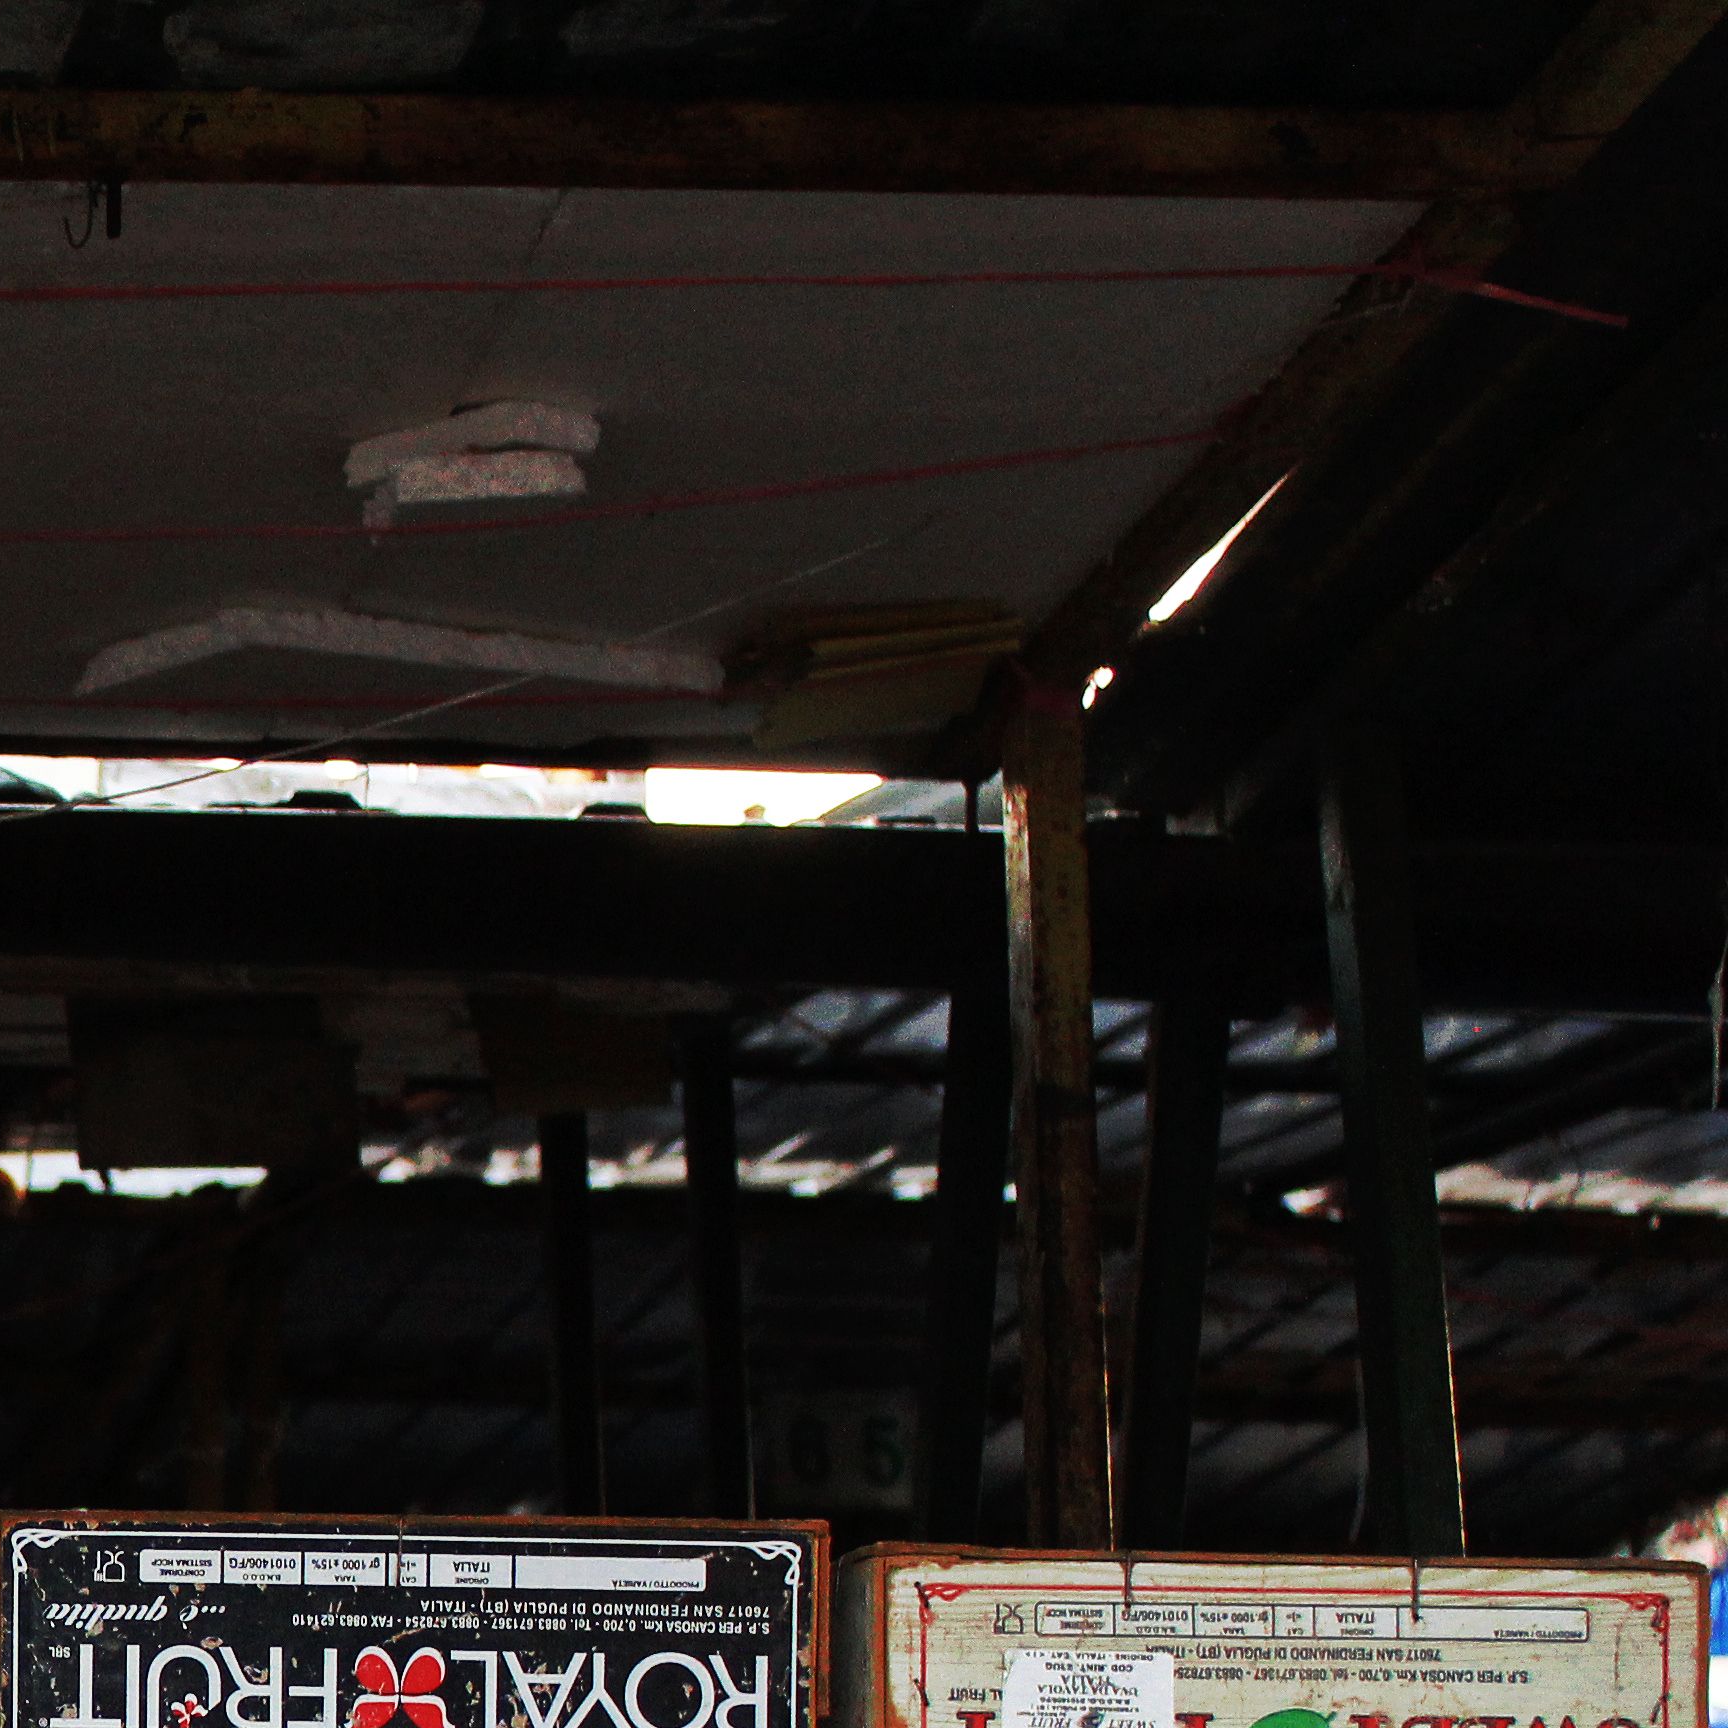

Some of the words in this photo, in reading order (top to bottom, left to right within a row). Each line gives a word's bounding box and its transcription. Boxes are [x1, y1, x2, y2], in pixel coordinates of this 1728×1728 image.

[229, 1557, 296, 1568] 0101406/FG
[453, 1560, 490, 1572] ITALIA
[420, 1600, 466, 1612] ITALIA
[479, 1598, 509, 1614] (BT)
[514, 1602, 567, 1614] PUGLIA
[592, 1603, 689, 1617] FERDINANDO
[694, 1605, 723, 1617] SAN
[729, 1605, 769, 1618] 76017
[43, 1596, 167, 1629] qualità
[369, 1614, 393, 1627] FAX
[492, 1617, 566, 1630] 0883.671367
[666, 1620, 716, 1633] CANOSA
[719, 1621, 742, 1633] PER
[49, 1646, 70, 1657] SRL
